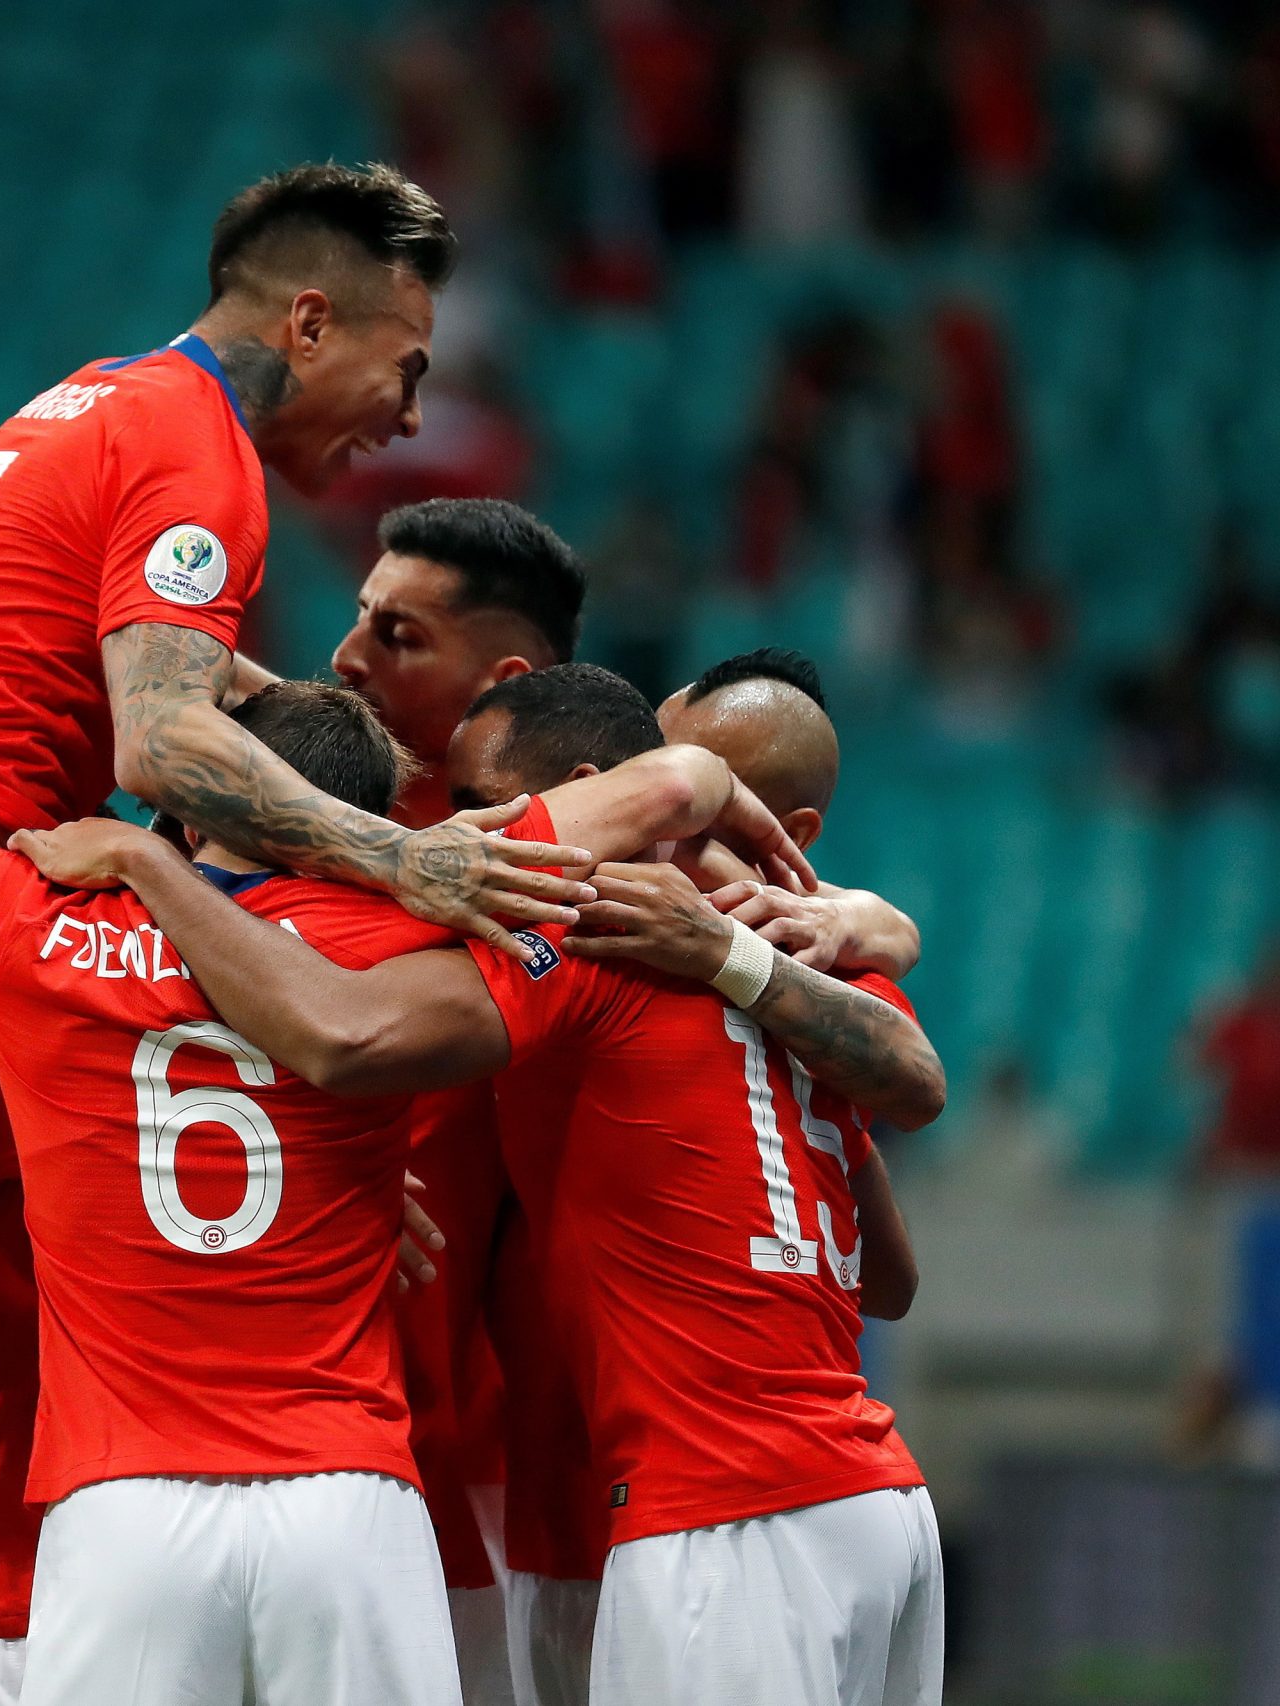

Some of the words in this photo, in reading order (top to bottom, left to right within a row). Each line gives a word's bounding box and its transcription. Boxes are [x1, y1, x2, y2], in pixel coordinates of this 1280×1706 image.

[147, 571, 171, 582] COPA
[171, 578, 209, 599] AMERICA
[131, 1021, 283, 1254] 6
[723, 1007, 863, 1290] 15
